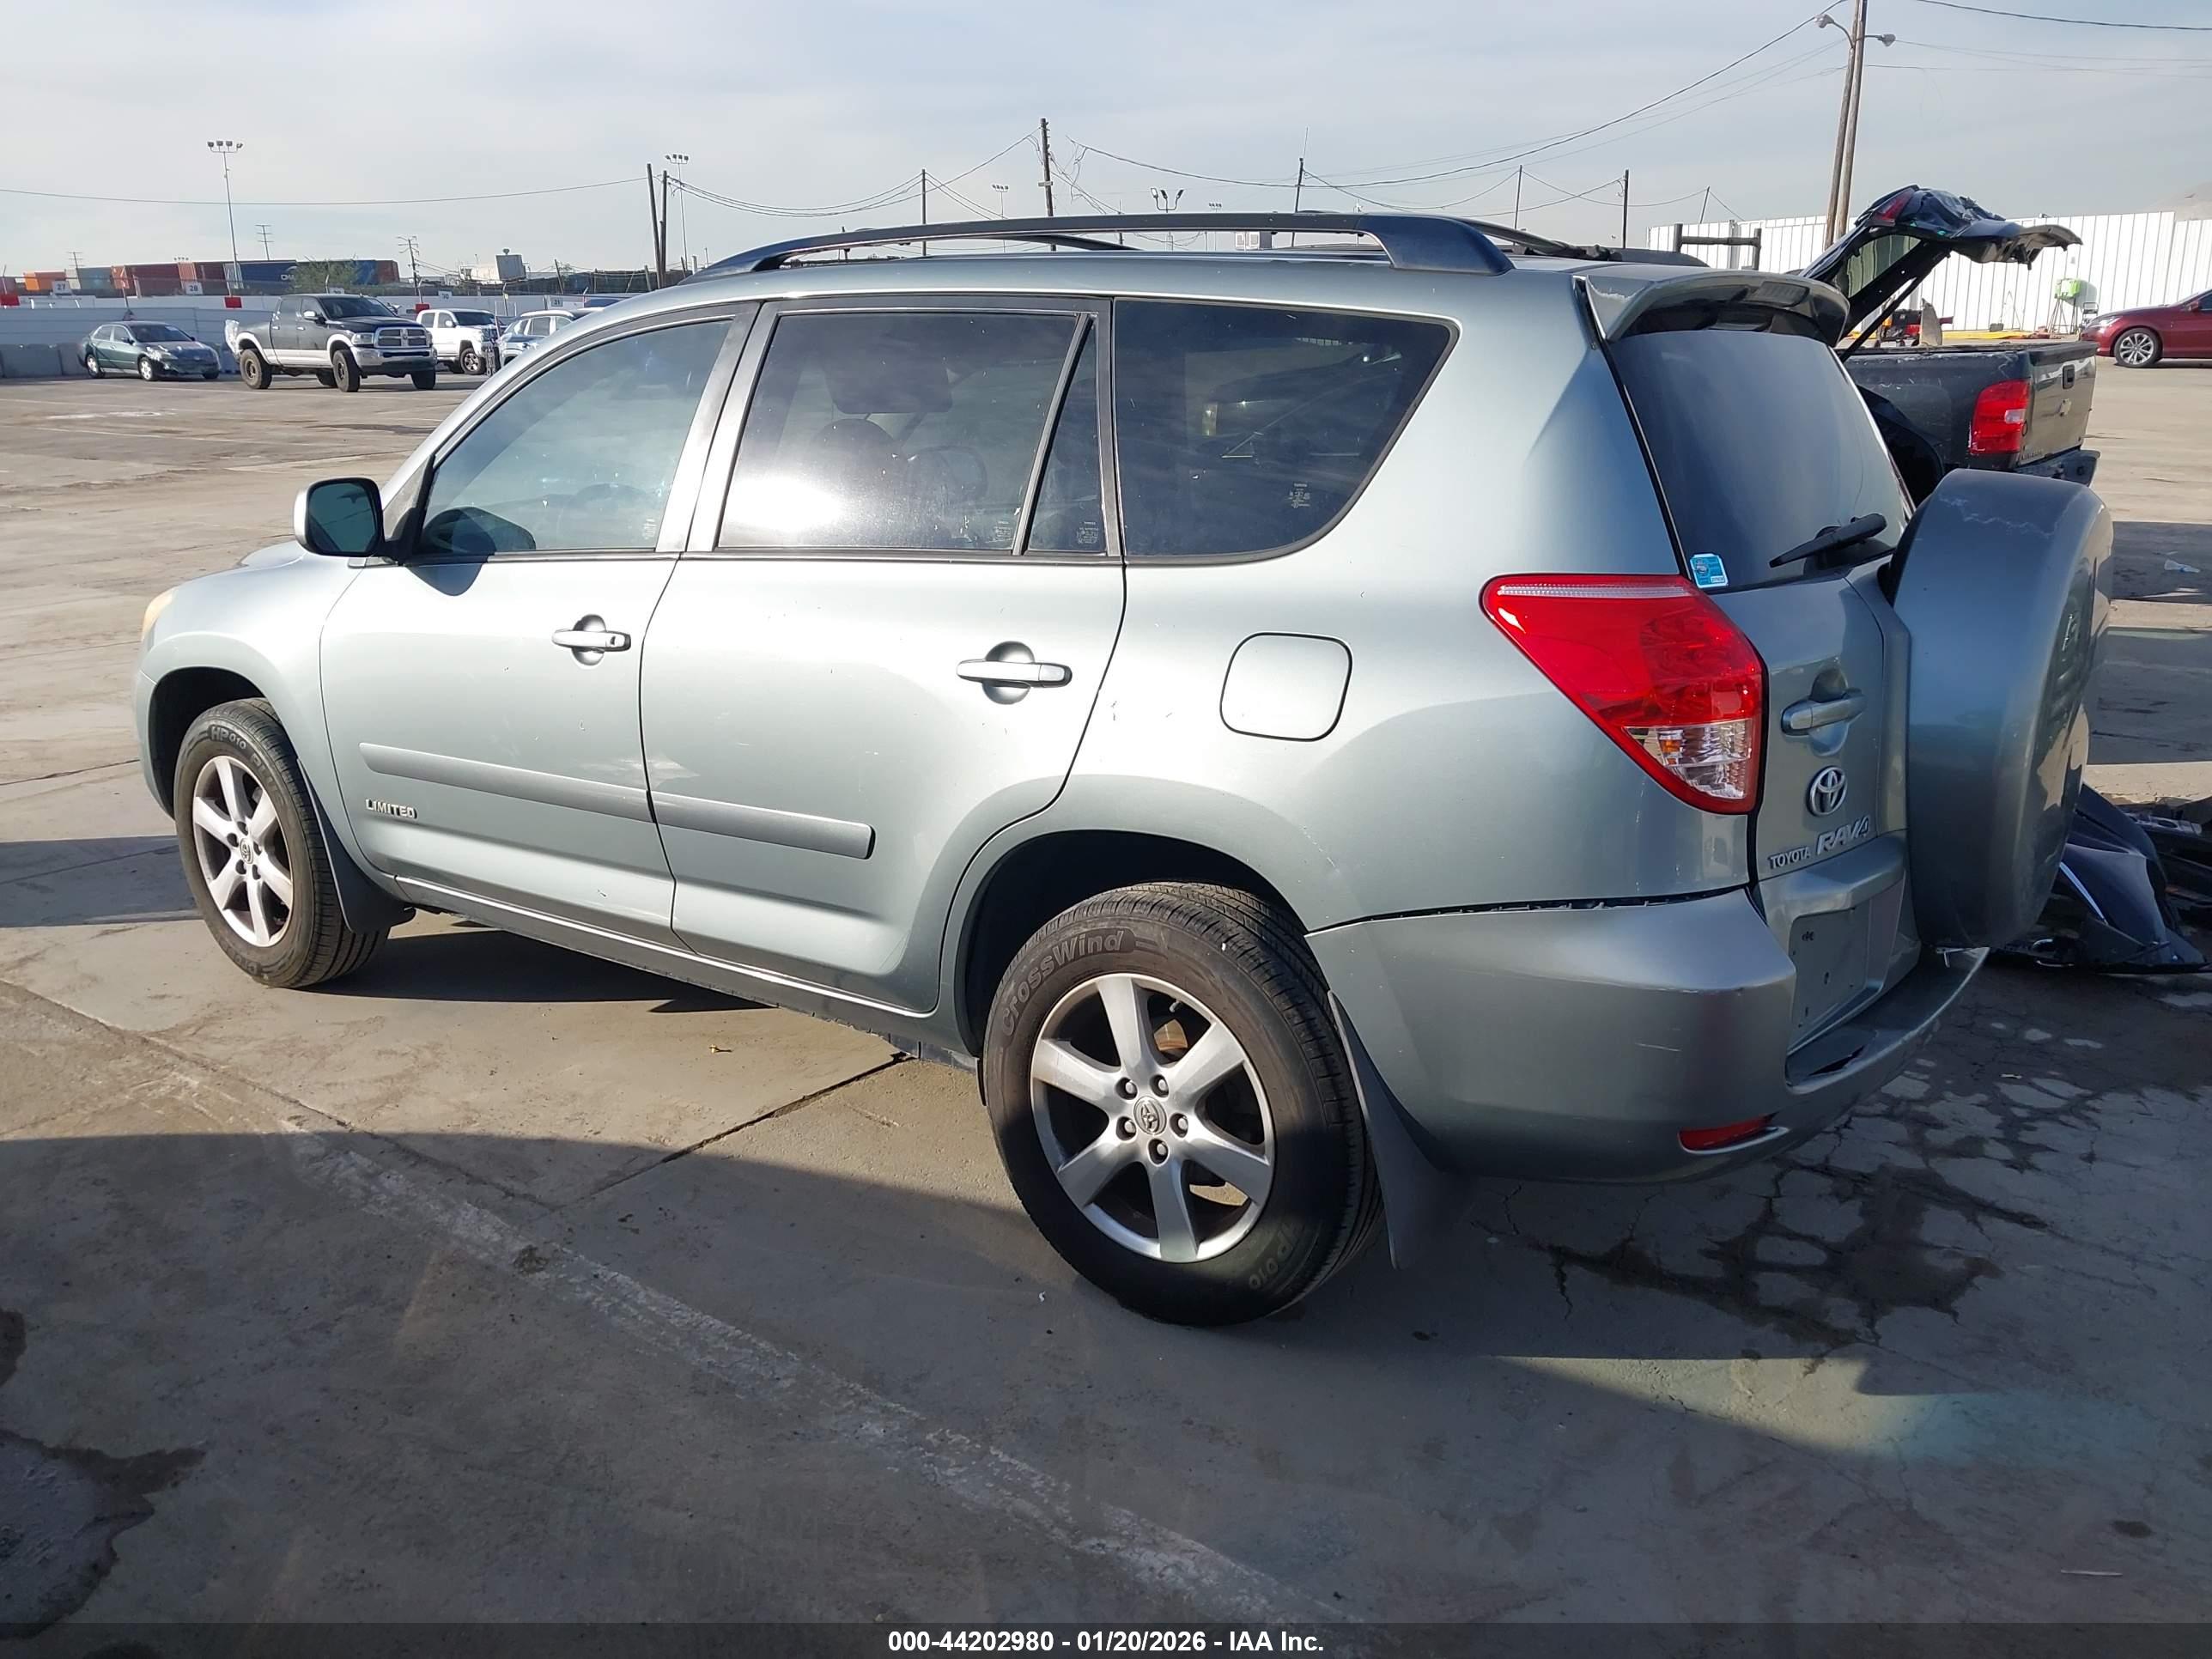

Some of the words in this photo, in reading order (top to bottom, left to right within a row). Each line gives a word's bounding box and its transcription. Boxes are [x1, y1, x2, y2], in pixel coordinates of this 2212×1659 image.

[210, 726, 246, 750] HP010
[365, 799, 418, 820] LIMITED
[1768, 847, 1811, 869] TOYOTA
[1816, 816, 1869, 856] RAV4
[1002, 930, 1125, 1036] CrossWind
